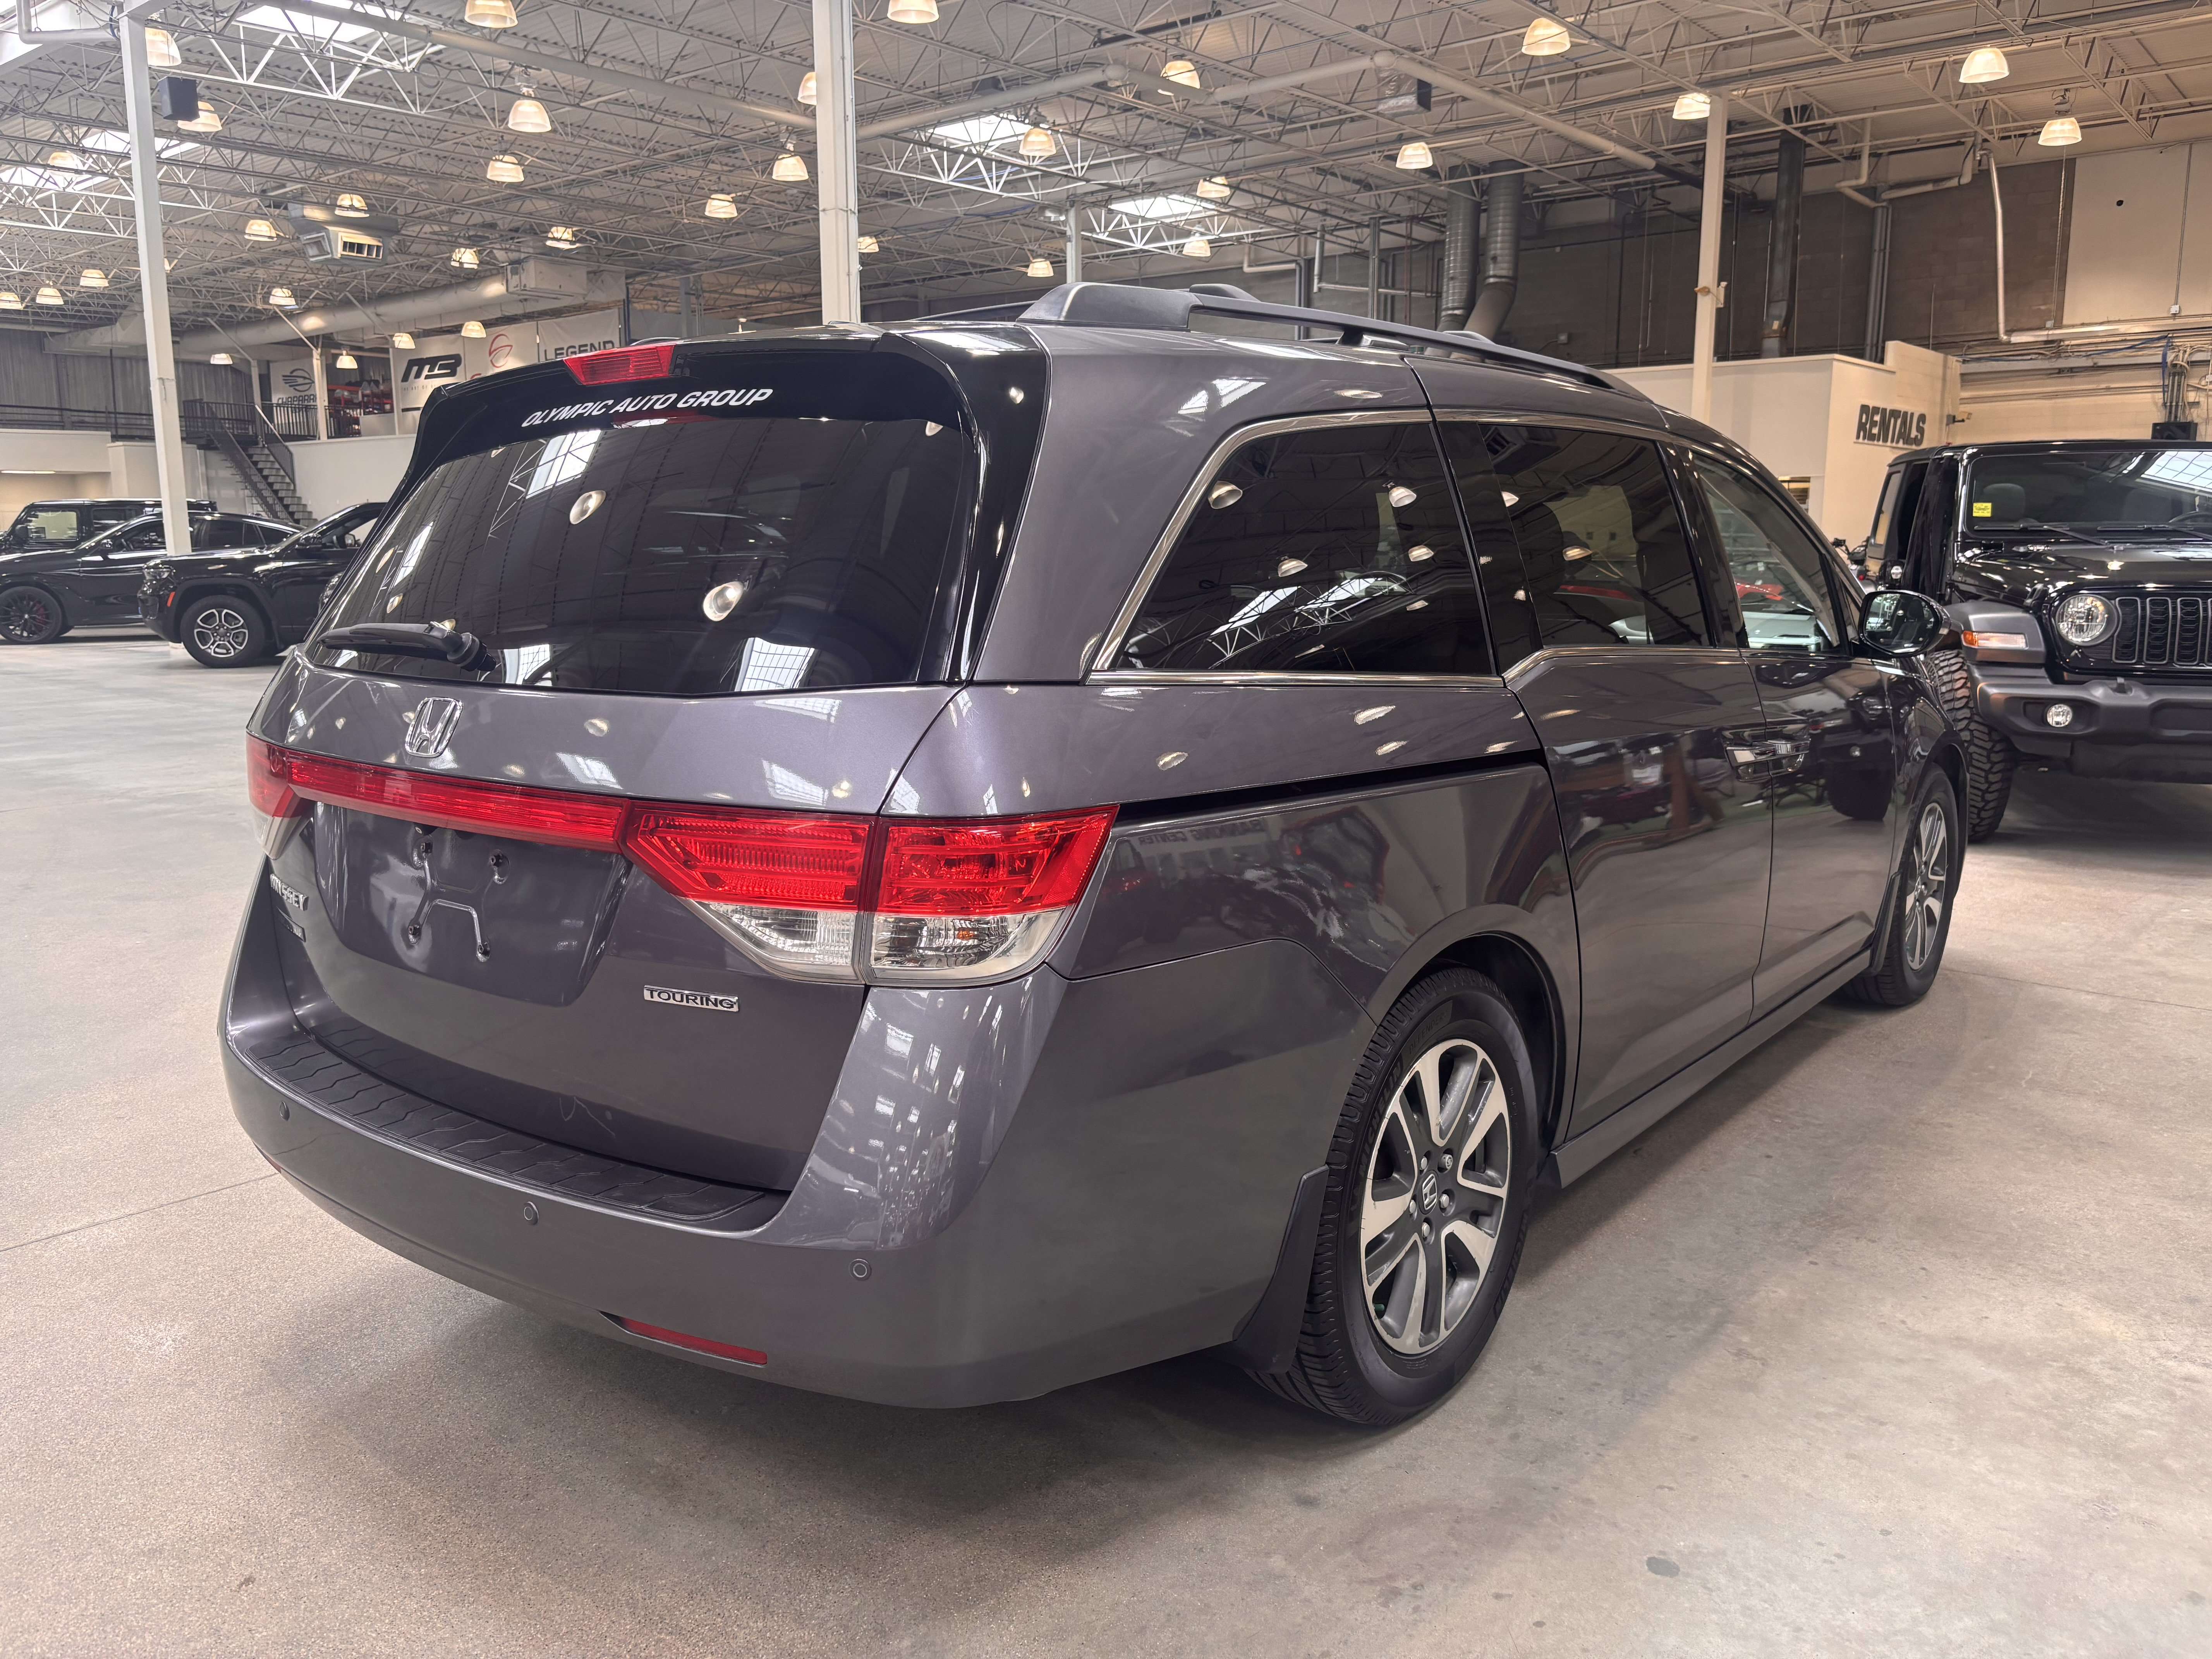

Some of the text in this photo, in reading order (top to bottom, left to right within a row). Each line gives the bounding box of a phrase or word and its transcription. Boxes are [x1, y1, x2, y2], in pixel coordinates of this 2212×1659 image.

[544, 340, 615, 361] LEGEND
[277, 393, 317, 404] CHAPARR
[522, 389, 774, 427] OLYMPIC AUTO GROUP
[1856, 404, 1926, 447] RENTALS
[646, 989, 734, 1009] TOURING
[1359, 1060, 1403, 1177] MICHELIN
